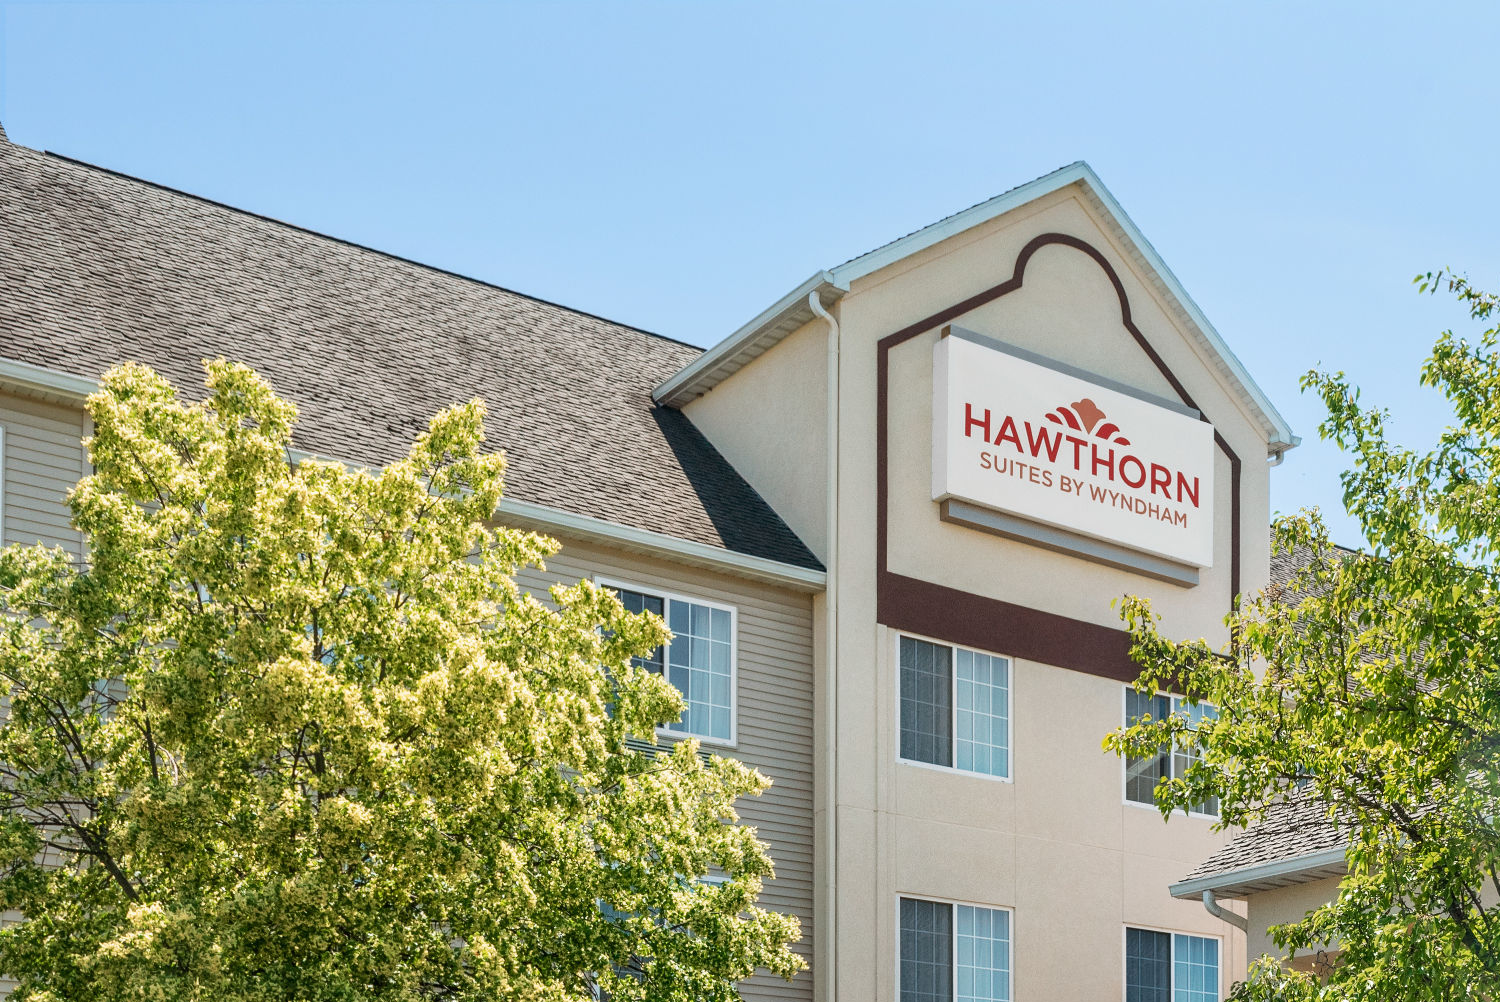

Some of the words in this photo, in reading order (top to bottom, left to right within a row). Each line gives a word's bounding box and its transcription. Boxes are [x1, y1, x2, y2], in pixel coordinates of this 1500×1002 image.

[964, 402, 1200, 508] HAWTHORN
[980, 451, 1053, 487] SUITES
[1060, 475, 1084, 496] BY
[1089, 484, 1188, 528] WYNDHAM
